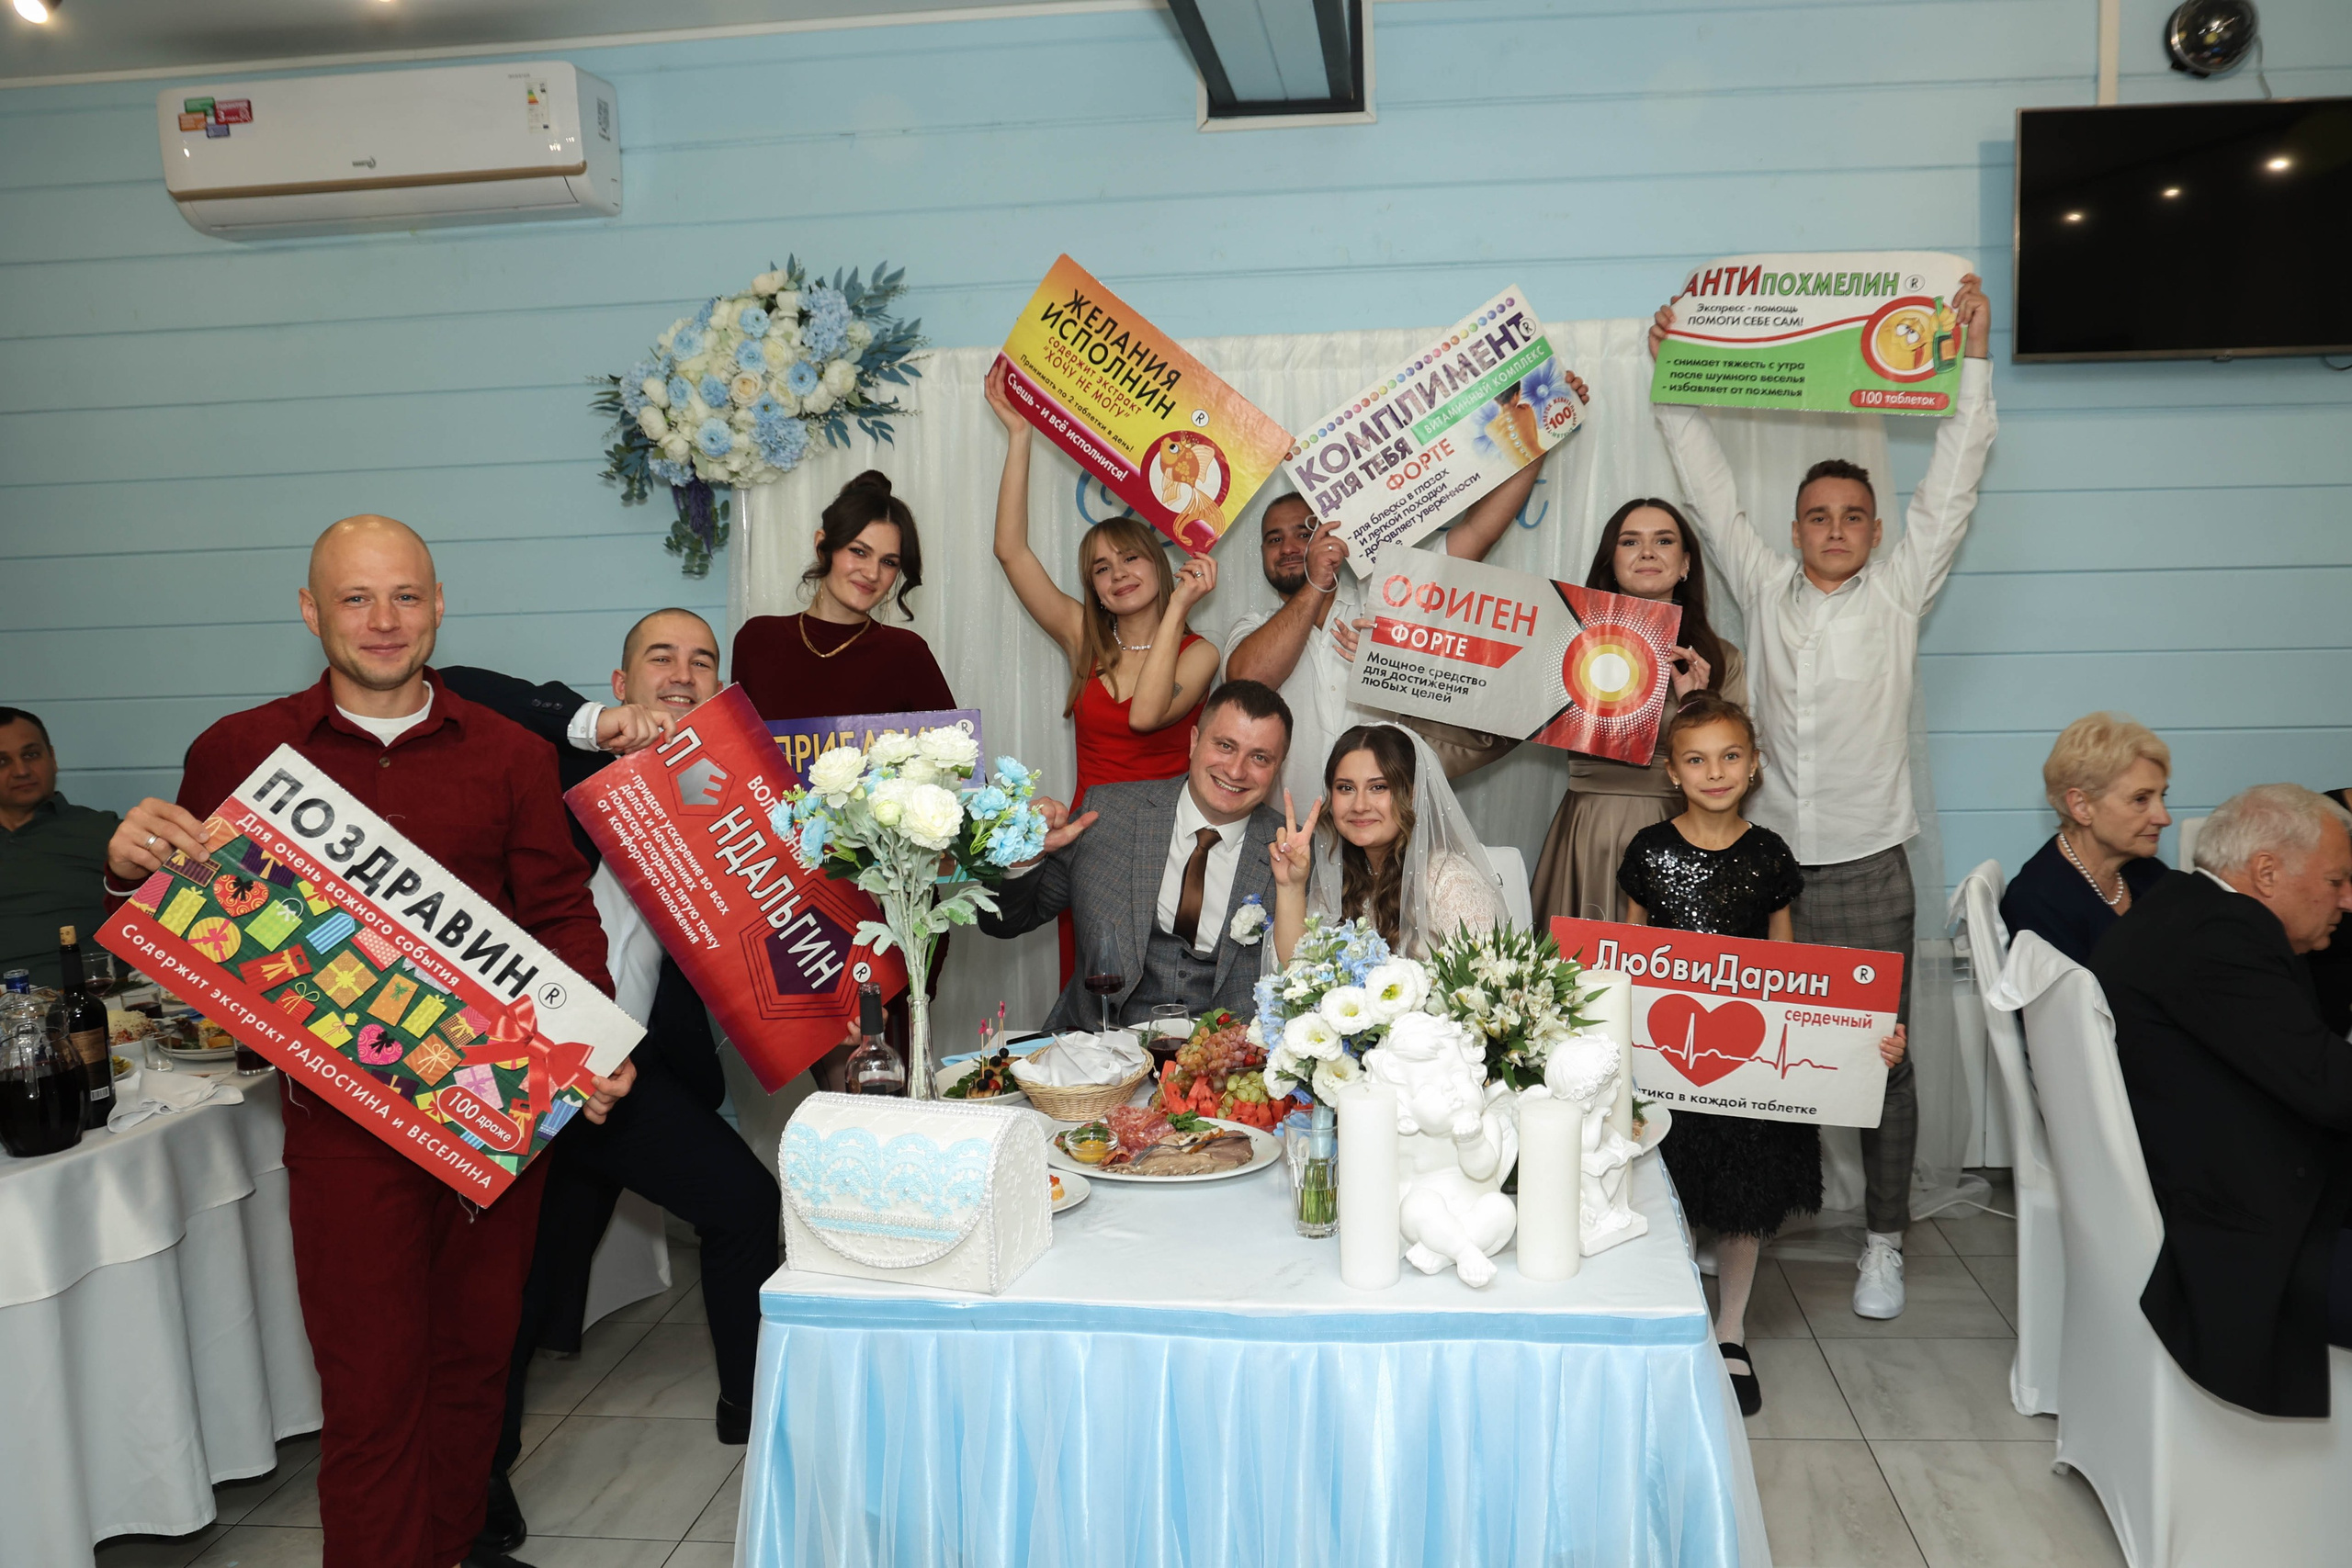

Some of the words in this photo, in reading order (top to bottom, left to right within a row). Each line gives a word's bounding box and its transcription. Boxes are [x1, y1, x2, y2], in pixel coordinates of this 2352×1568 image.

[1684, 265, 1901, 297] АНТИПОХМЕЛИН
[1696, 303, 1746, 314] Экспресс
[1754, 304, 1798, 313] помощь
[1063, 288, 1182, 391] ЖЕЛАНИЯ
[1687, 315, 1741, 326] ПОМОГИ
[1743, 315, 1770, 326] СЕБЕ
[1774, 316, 1804, 327] САМ!
[1040, 301, 1176, 420] ИСПОЛНИН
[1048, 336, 1095, 377] содержит
[1096, 376, 1141, 414] экстракт
[1075, 375, 1091, 392] НЕ
[1423, 381, 1492, 434] ВИТАМИННЫЙ
[1489, 345, 1544, 388] КОМПЛЕКС
[1668, 371, 1703, 379] после
[1705, 372, 1758, 384] шумного
[1760, 375, 1805, 384] веселья
[1668, 382, 1728, 394] избавляет
[1730, 387, 1744, 395] от
[1745, 388, 1803, 397] похмелья
[1673, 358, 1720, 367] снимает
[1722, 360, 1767, 368] тяжесть
[1776, 362, 1805, 372] утра
[1007, 372, 1034, 405] Съешь
[1040, 407, 1049, 418] и
[1048, 414, 1069, 432] всё
[1065, 428, 1128, 481] исполнится!
[1020, 354, 1056, 389] Принимать
[1057, 388, 1067, 398] по
[1068, 395, 1074, 403] 2
[1074, 401, 1106, 430] таблетки
[1111, 434, 1134, 452] день!
[1295, 310, 1533, 491] КОМПЛИМЕНТ
[1549, 405, 1572, 429] 100
[1860, 390, 1883, 405] 100
[1884, 391, 1936, 406] таблеток
[1314, 470, 1363, 518] ДЛЯ
[1358, 436, 1413, 480] ТЕБЯ
[1385, 437, 1454, 490] ФОРТЕ
[1352, 522, 1371, 539] для
[1370, 498, 1407, 525] блеска
[1413, 468, 1449, 495] глазах
[1359, 537, 1367, 546] и
[1367, 511, 1402, 540] легкой
[1402, 482, 1447, 516] походки
[1415, 472, 1480, 523] уверенности
[1383, 574, 1539, 637] ОФИГЕН
[1366, 651, 1425, 674] Мощное
[1428, 667, 1487, 687] средство
[1391, 624, 1469, 658] ФОРТЕ
[1361, 676, 1408, 694] любых
[1410, 687, 1453, 704] целей
[1363, 665, 1387, 677] для
[1389, 671, 1470, 695] достижения
[607, 789, 647, 840] помогает
[642, 840, 676, 887] оторвать
[673, 887, 699, 919] пятую
[695, 919, 719, 949] точку
[617, 784, 648, 818] делах
[644, 818, 654, 828] и
[650, 826, 696, 891] начинаниях
[631, 774, 667, 819] придает
[658, 819, 703, 876] ускорение
[699, 875, 712, 890] во
[708, 890, 729, 915] всех
[235, 812, 272, 842] Для
[274, 842, 321, 881] очень
[324, 881, 392, 934] важного
[394, 935, 459, 986] события
[252, 771, 538, 1008] ПОЗДРАВИН
[597, 799, 611, 812] от
[607, 815, 660, 886] комфортного
[656, 886, 699, 943] положения
[1592, 938, 1831, 1001] ЛюбвиДарин
[1784, 1010, 1873, 1030] сердечный
[121, 924, 209, 988] Содержит
[209, 988, 285, 1042] экстракт
[287, 1040, 390, 1118] РАДОСТИНА
[391, 1117, 403, 1128] и
[406, 1124, 491, 1188] ВЕСЕЛИНА
[448, 1091, 480, 1119] 100
[474, 1114, 511, 1142] драже
[1679, 1093, 1686, 1101] в
[1690, 1095, 1747, 1109] каждой
[1750, 1100, 1818, 1116] таблетке
